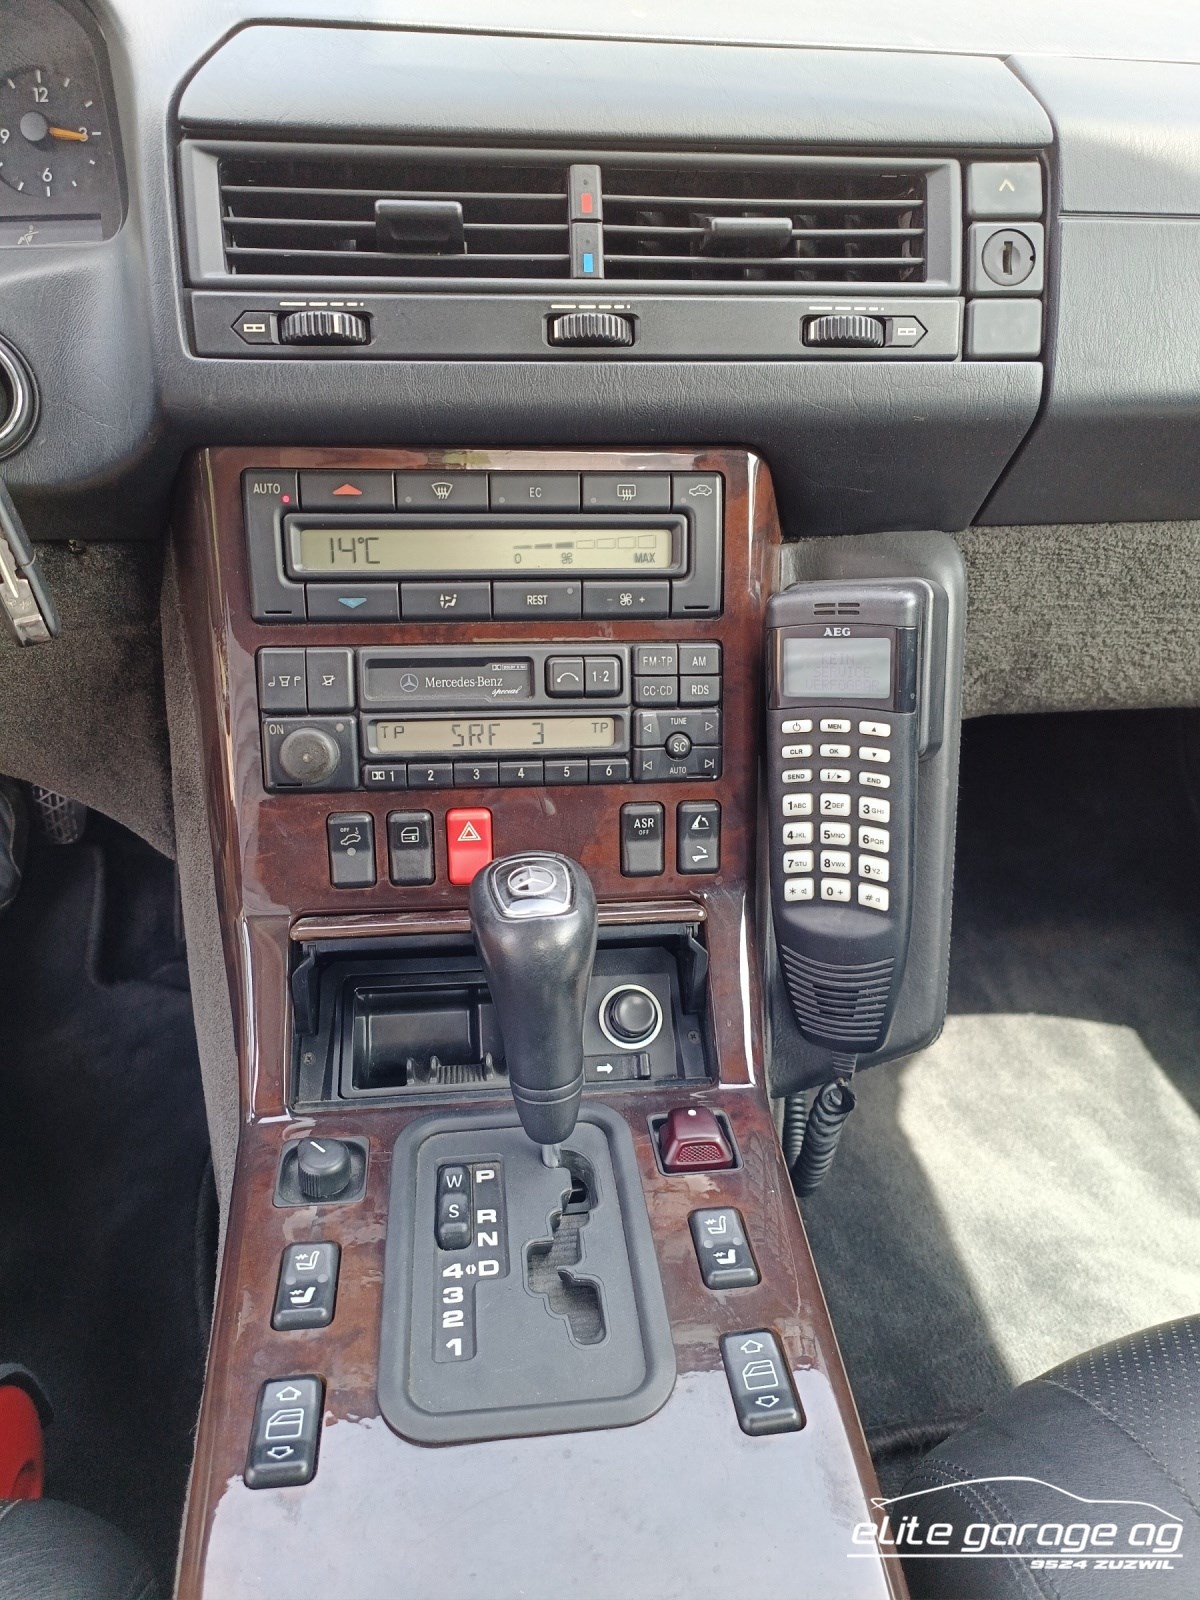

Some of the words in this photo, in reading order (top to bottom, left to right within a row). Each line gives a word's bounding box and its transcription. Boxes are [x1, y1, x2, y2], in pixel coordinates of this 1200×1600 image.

[33, 87, 49, 103] 12
[0, 128, 10, 144] 9
[42, 167, 53, 182] 6
[253, 483, 281, 494] AUTO
[529, 487, 542, 498] EC
[330, 537, 381, 564] 14°C
[634, 552, 656, 564] MAX
[527, 595, 548, 605] REST
[824, 627, 851, 637] AEG
[692, 656, 707, 667] AM
[425, 675, 503, 688] Mercedes-Benz
[491, 685, 523, 698] special
[691, 684, 709, 695] RDS
[670, 717, 687, 725] TUNE
[268, 724, 284, 735] ON
[380, 725, 405, 739] TP
[451, 723, 501, 748] SRF
[531, 722, 545, 745] 3
[591, 722, 609, 734] TP
[673, 742, 686, 752] SC
[390, 771, 395, 782] 1
[427, 769, 434, 781] 2
[473, 768, 480, 780] 3
[517, 767, 525, 778] 4
[563, 766, 570, 778] 5
[606, 765, 613, 776] 6
[669, 766, 687, 775] AUTO
[633, 818, 655, 829] ASR
[826, 887, 833, 896] 0
[446, 1174, 462, 1188] W
[475, 1169, 495, 1183] P
[448, 1204, 459, 1218] S
[477, 1209, 497, 1224] R
[477, 1231, 498, 1247] N
[442, 1263, 463, 1279] 4
[478, 1260, 499, 1277] D
[442, 1287, 464, 1304] 3
[442, 1310, 464, 1328] 2
[446, 1338, 462, 1356] 1
